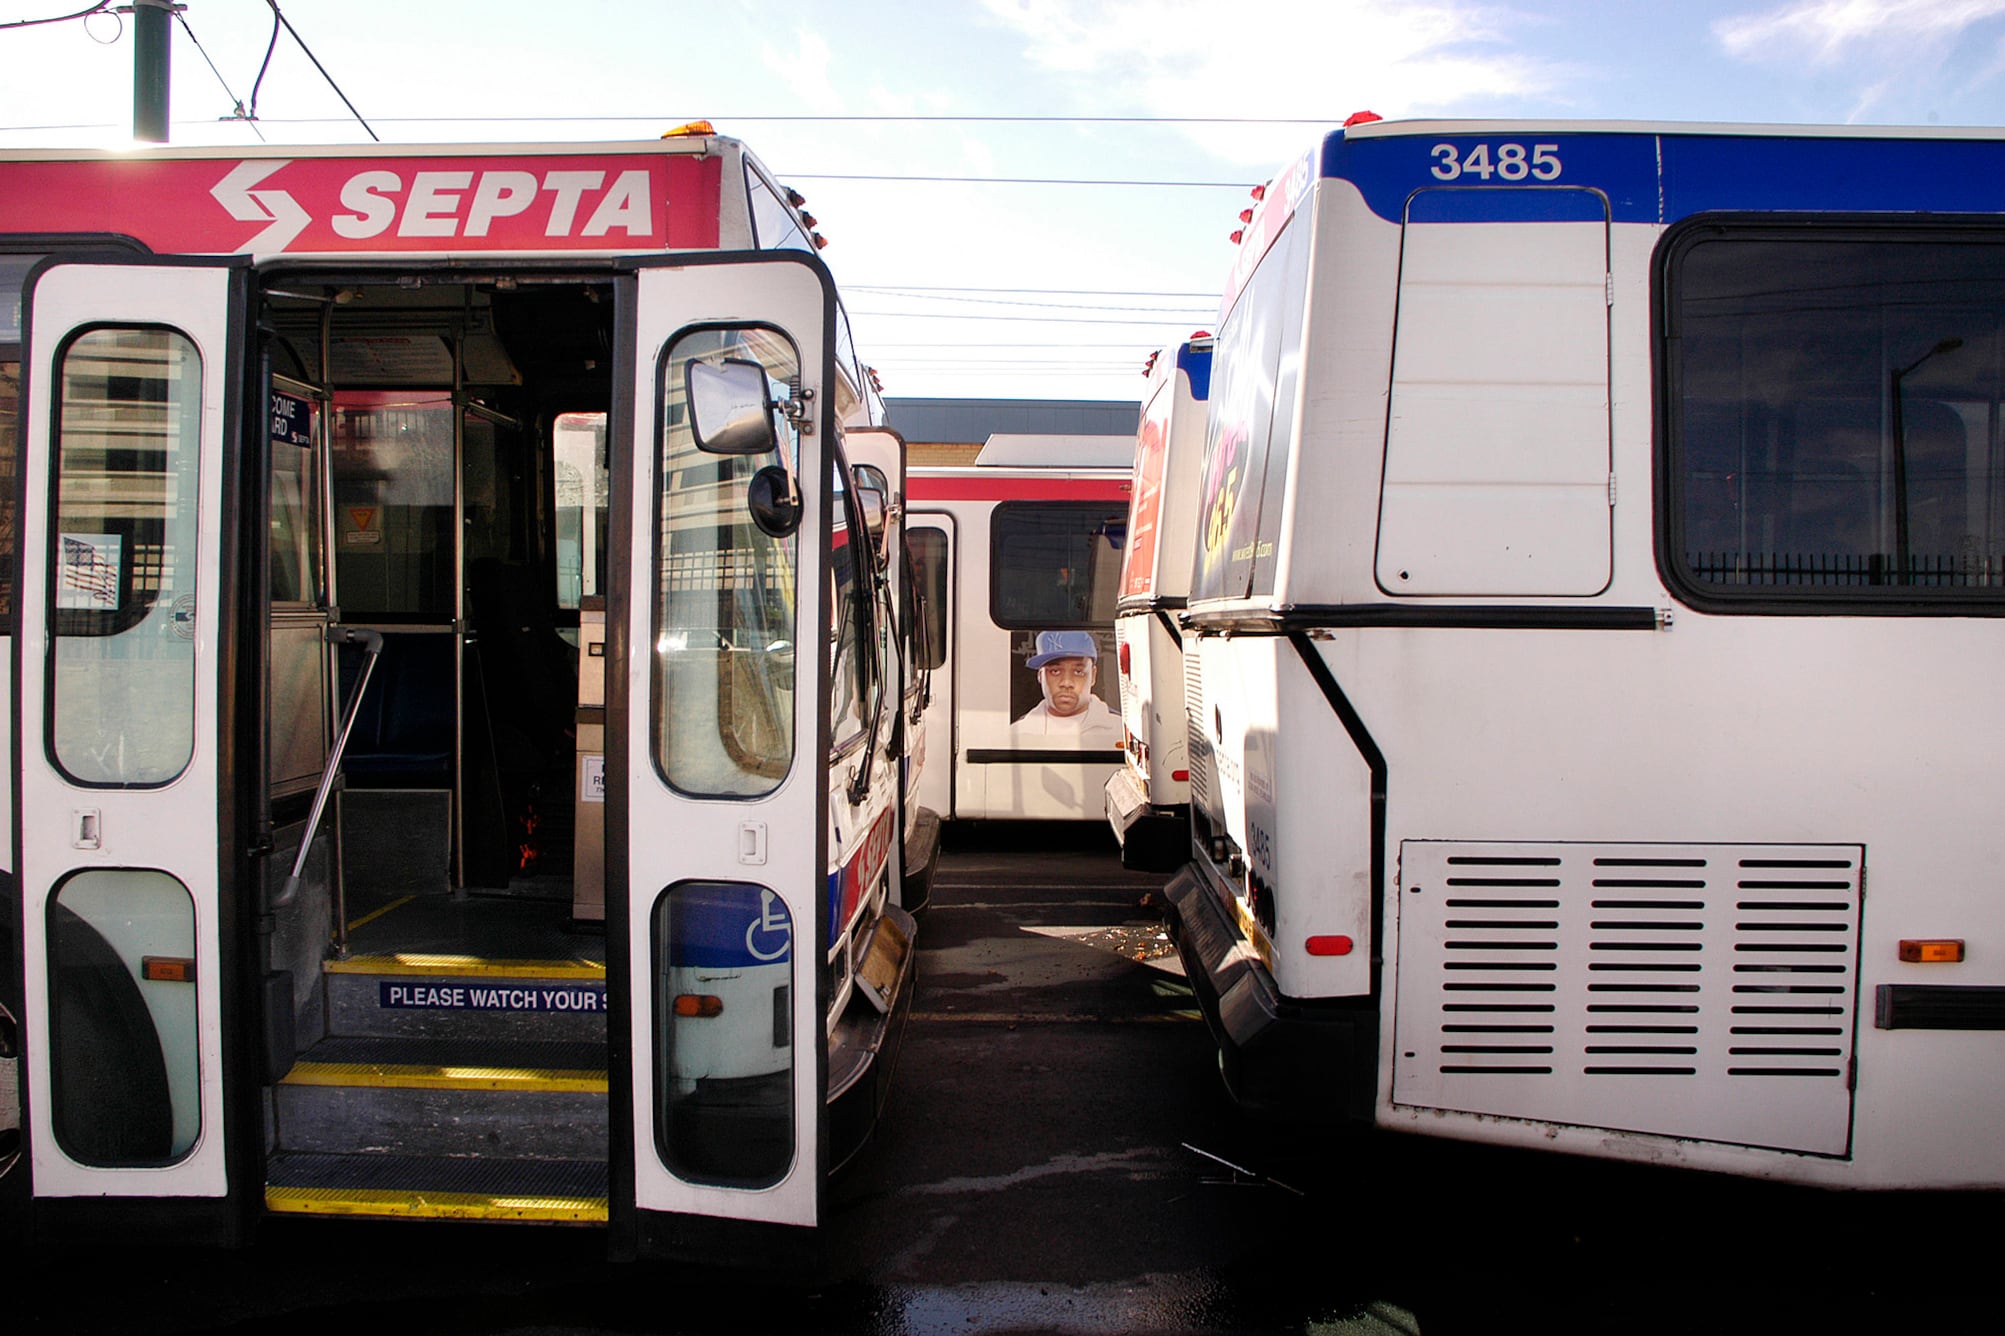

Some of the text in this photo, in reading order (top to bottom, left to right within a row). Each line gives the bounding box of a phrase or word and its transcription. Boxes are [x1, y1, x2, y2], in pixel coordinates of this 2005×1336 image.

[1430, 143, 1562, 181] 3485
[331, 169, 653, 239] SEPTA
[1250, 821, 1271, 871] 3485
[390, 986, 465, 1007] PLEASE
[469, 988, 538, 1009] WATCH
[542, 990, 597, 1011] YOUR
